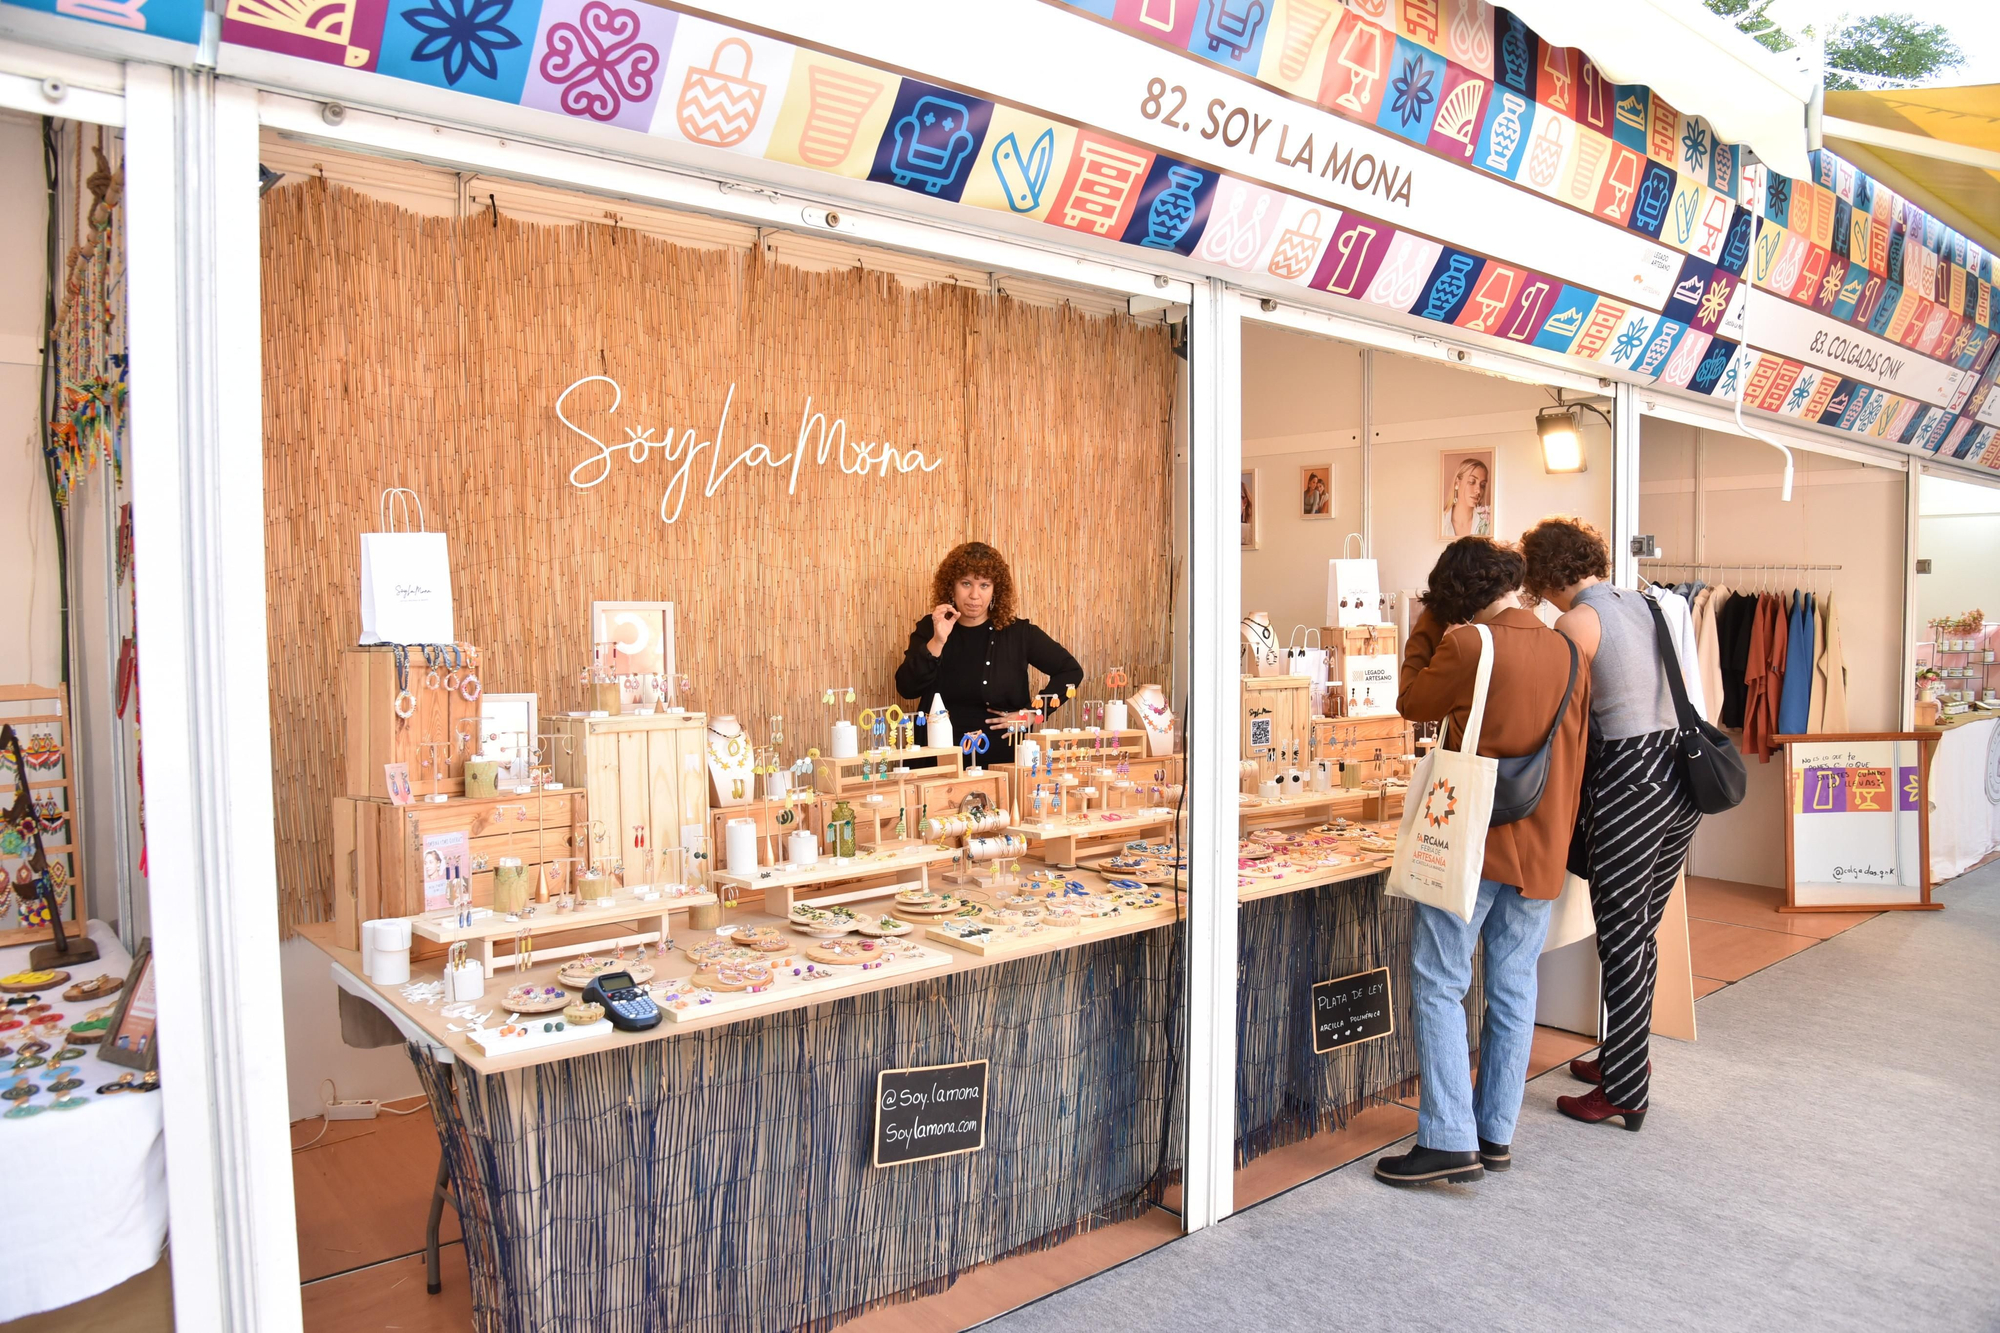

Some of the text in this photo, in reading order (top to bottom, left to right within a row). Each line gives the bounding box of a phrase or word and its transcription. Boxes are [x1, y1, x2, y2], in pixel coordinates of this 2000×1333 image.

[1140, 76, 1412, 207] 82. SOY LA MONA
[1810, 330, 1905, 381] 83. COLGADAS QNK
[1417, 833, 1449, 850] FARCAMA
[1413, 850, 1446, 867] ARTESANÍA
[1318, 983, 1384, 1010] PLATA DE LEY
[1320, 1020, 1345, 1032] ARCILLA
[886, 1115, 977, 1151] Soylamona.com
